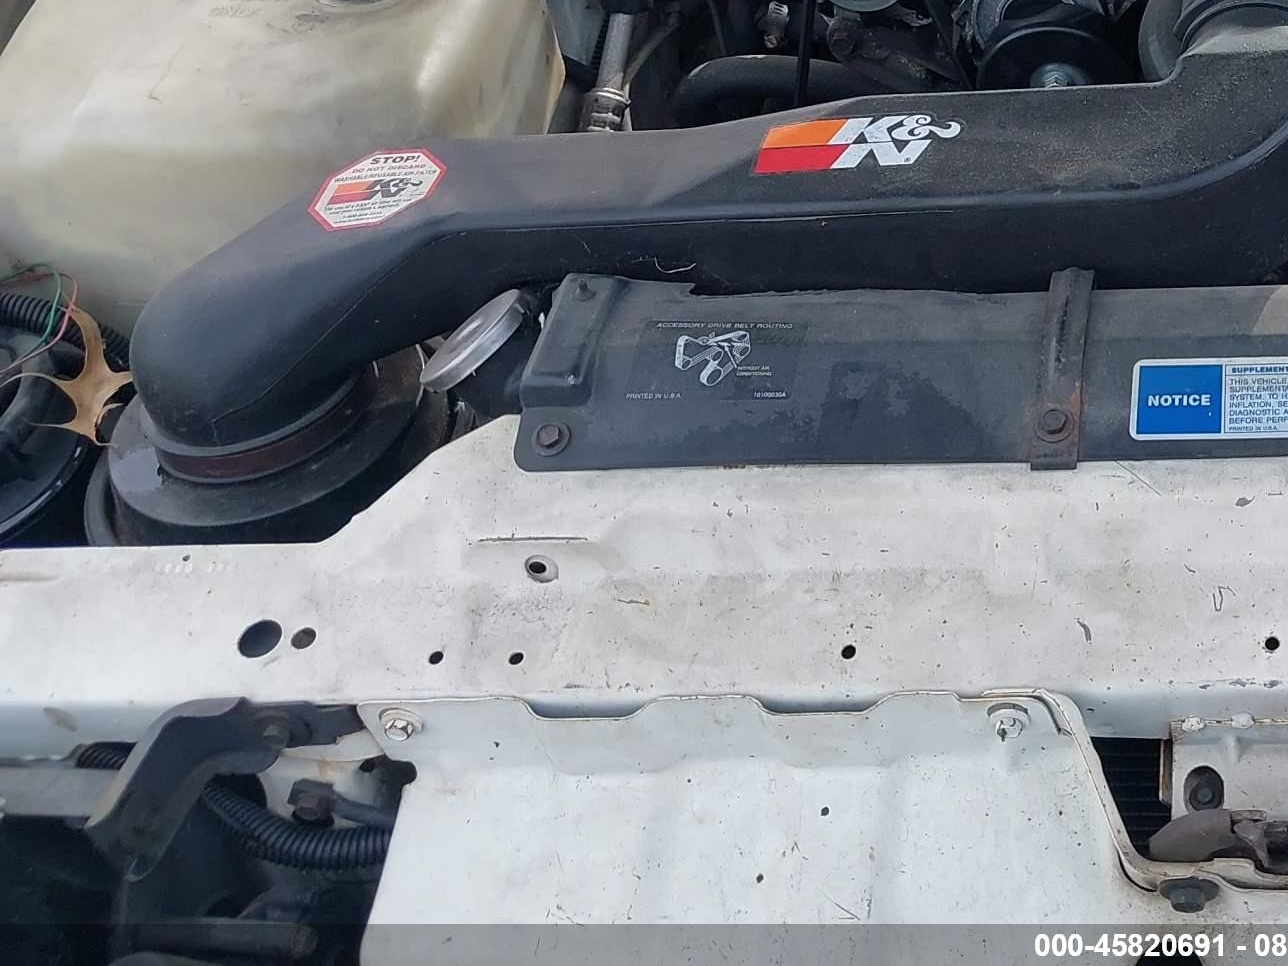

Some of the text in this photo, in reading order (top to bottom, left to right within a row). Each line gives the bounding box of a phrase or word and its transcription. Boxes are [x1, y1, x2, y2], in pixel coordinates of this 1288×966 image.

[827, 114, 960, 169] K&N
[370, 155, 421, 164] STOP!
[1147, 394, 1212, 408] NOTICE
